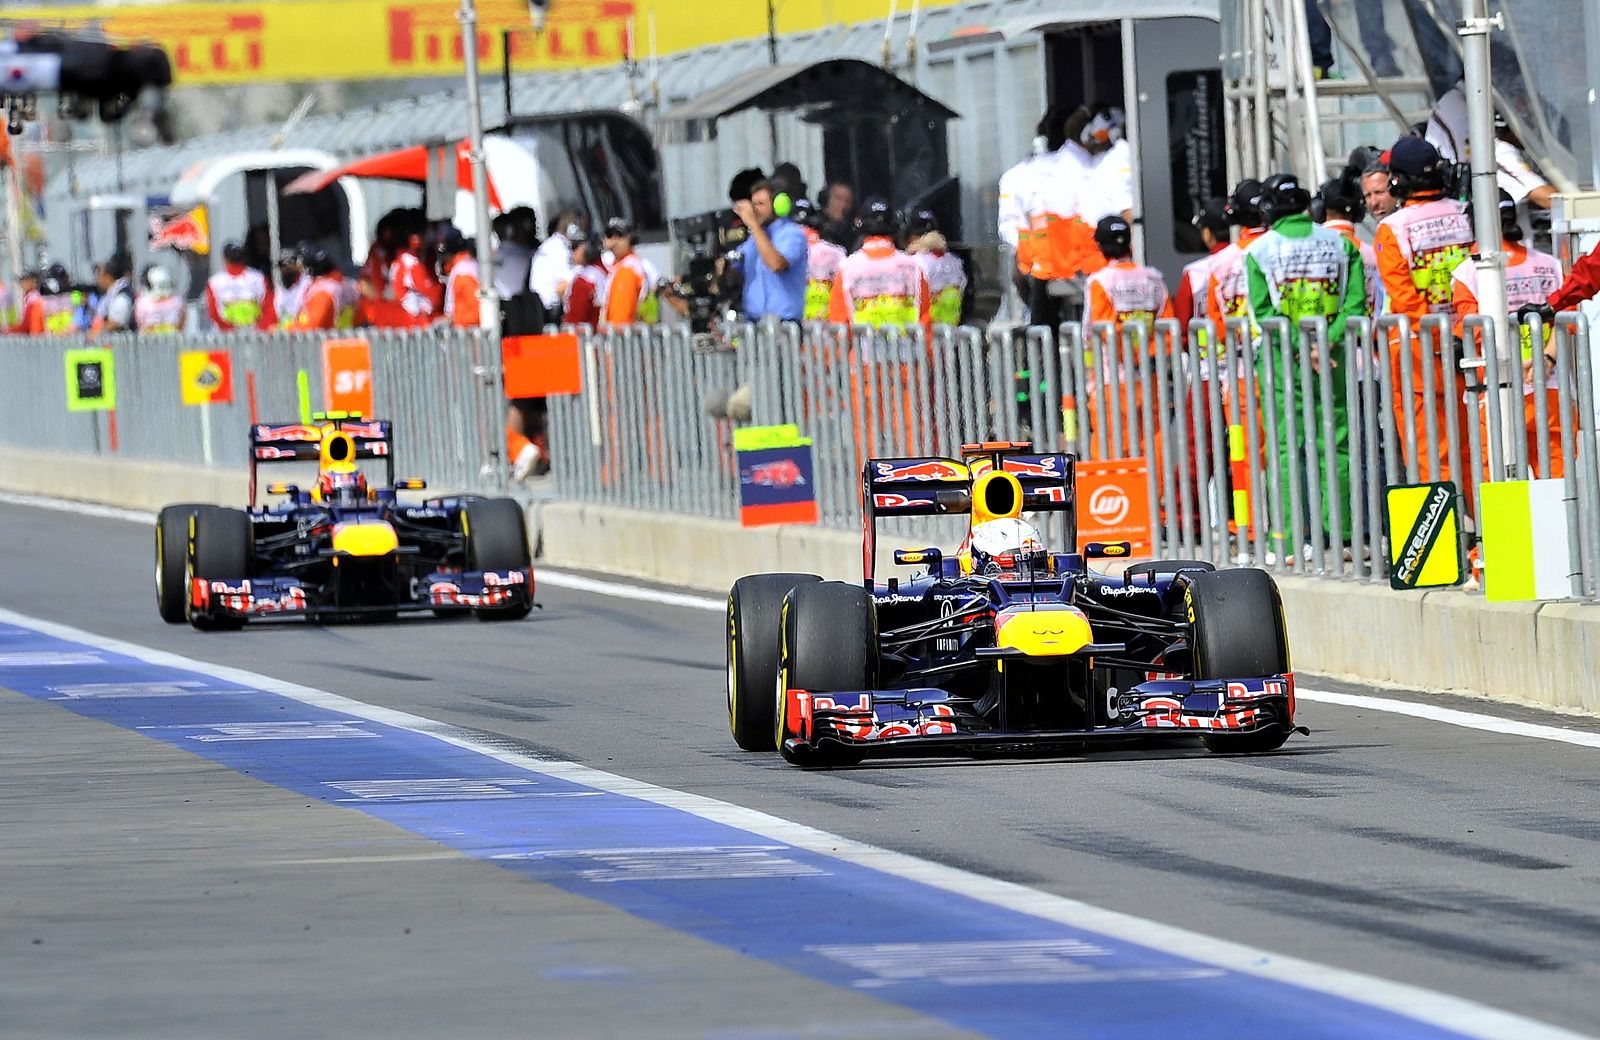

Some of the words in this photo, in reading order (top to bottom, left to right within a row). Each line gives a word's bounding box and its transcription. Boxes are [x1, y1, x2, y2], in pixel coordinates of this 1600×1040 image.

[1398, 487, 1450, 580] CATERHAM
[1100, 585, 1126, 598] Pepe
[1125, 584, 1158, 597] Jeans
